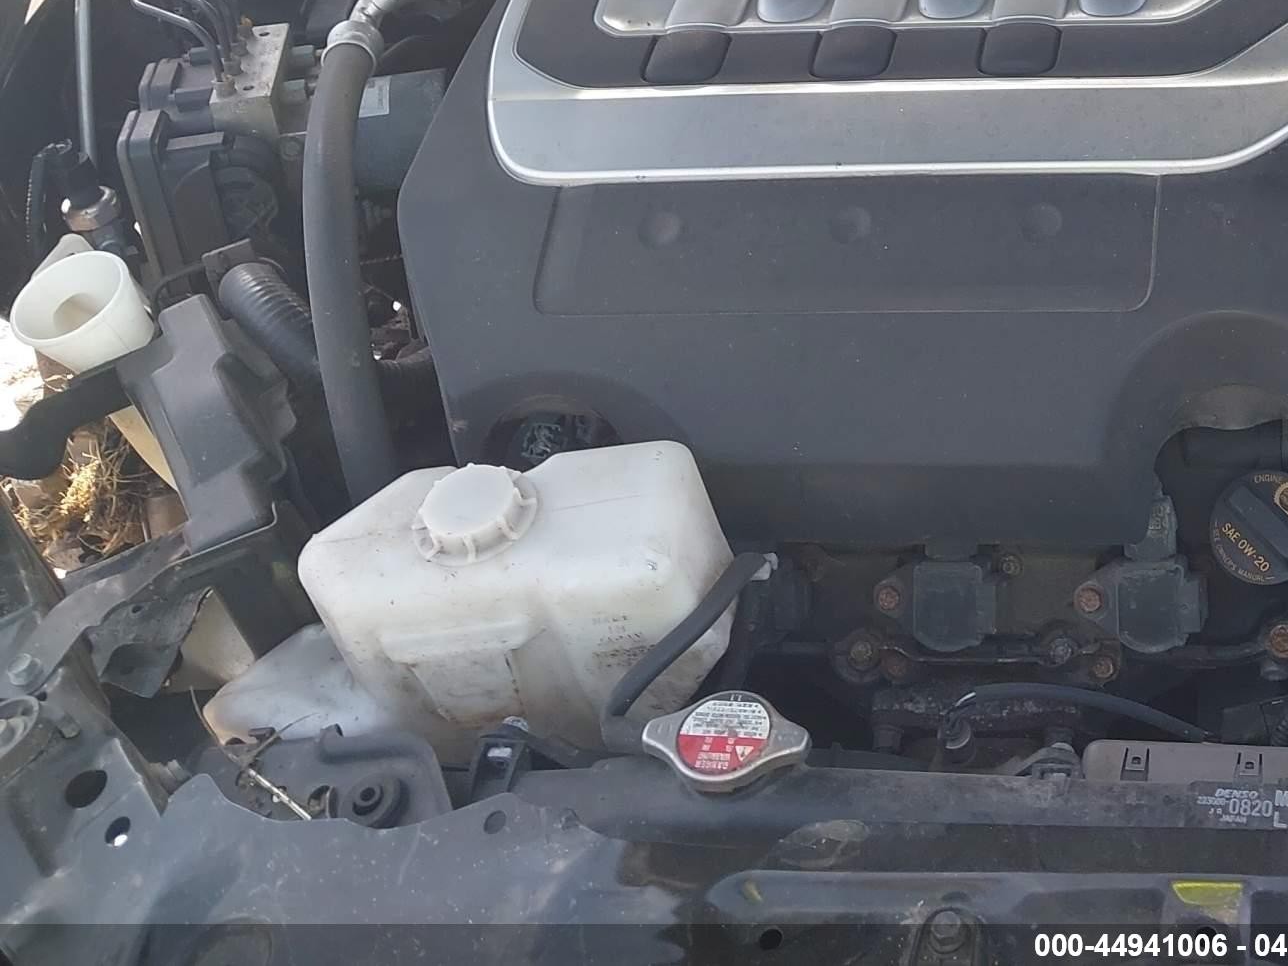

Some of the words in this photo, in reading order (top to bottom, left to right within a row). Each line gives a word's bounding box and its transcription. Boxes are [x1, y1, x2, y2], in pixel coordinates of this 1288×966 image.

[1222, 522, 1242, 543] SAE
[1215, 788, 1258, 800] DENSO
[1273, 811, 1288, 828] L
